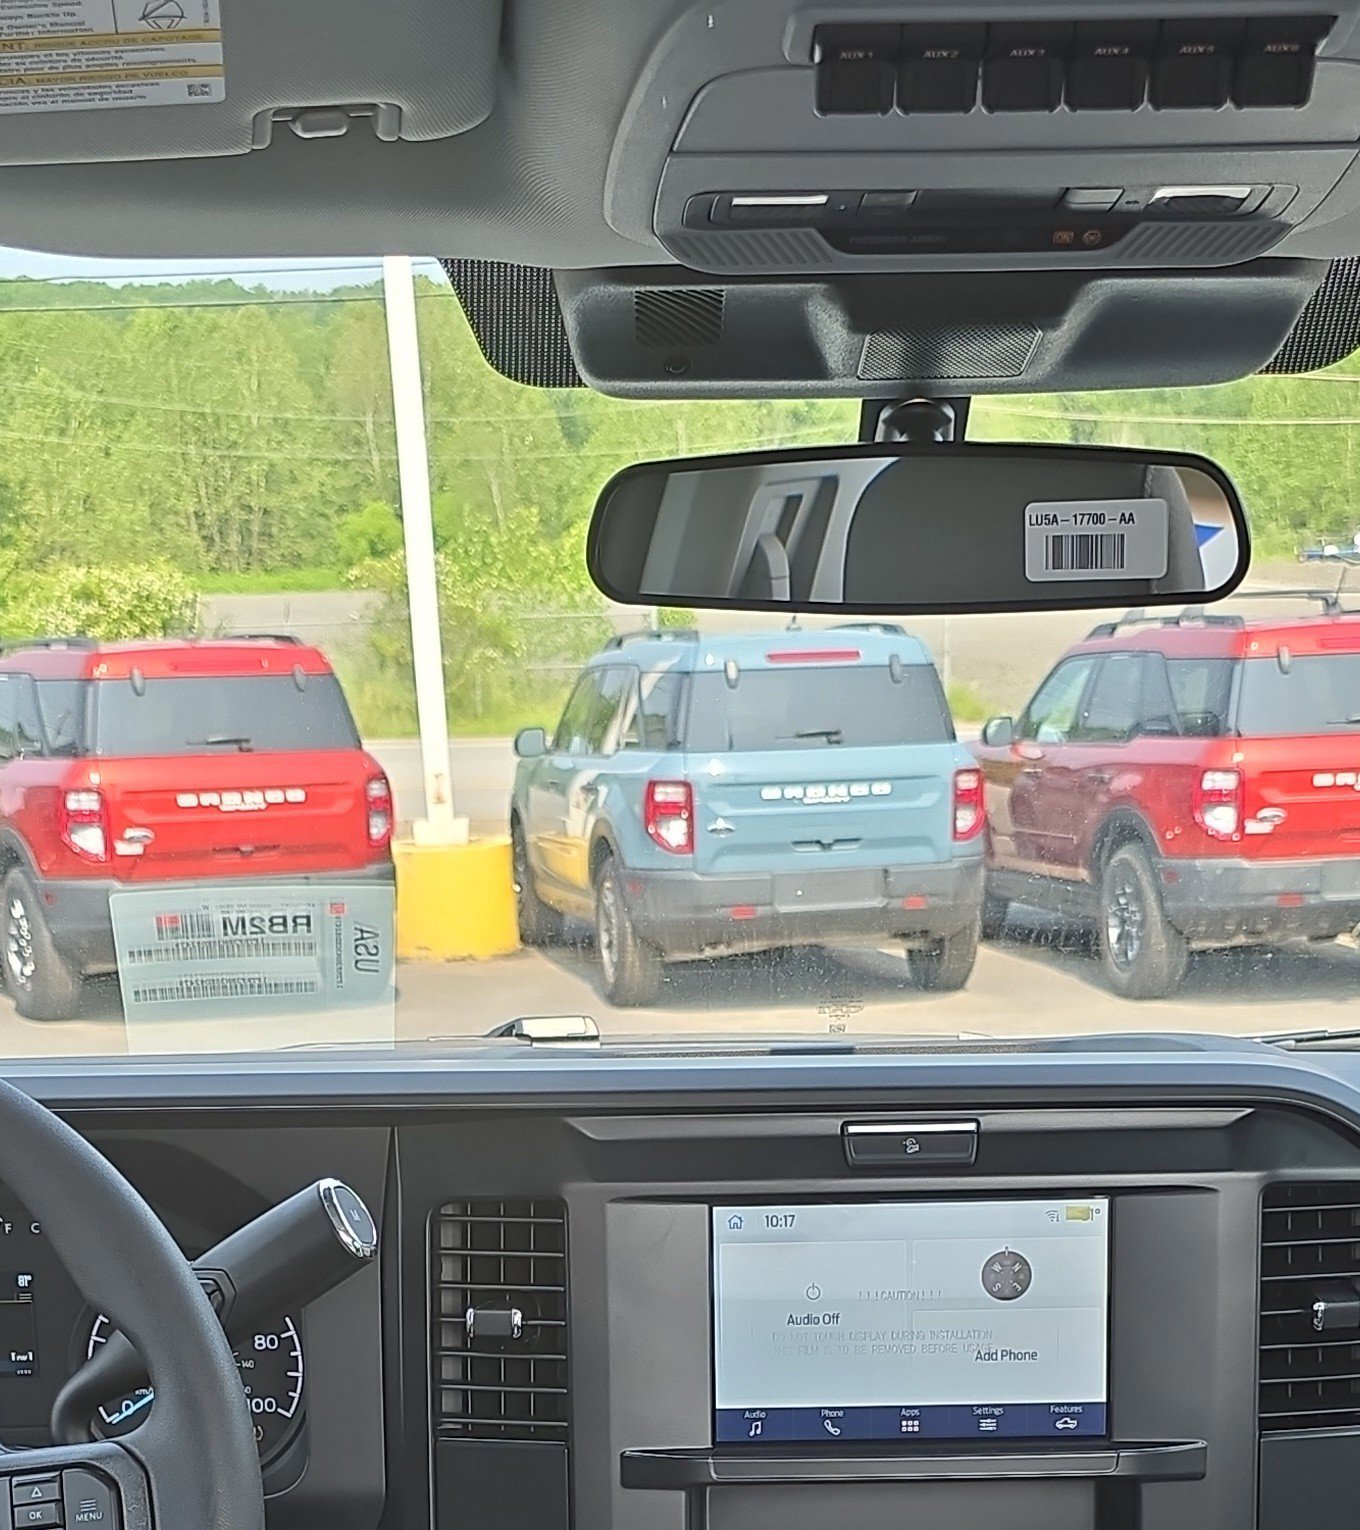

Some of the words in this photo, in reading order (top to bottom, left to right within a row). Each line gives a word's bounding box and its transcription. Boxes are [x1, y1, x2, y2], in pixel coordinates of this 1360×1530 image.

[764, 1215, 796, 1229] 10:17
[3, 1223, 13, 1235] F
[991, 1261, 1003, 1273] W
[1012, 1262, 1023, 1273] N
[992, 1282, 1002, 1292] S
[1012, 1282, 1022, 1292] E
[787, 1314, 820, 1326] Audio
[822, 1312, 841, 1326] Off
[930, 1329, 993, 1340] INSTALLATION
[253, 1334, 278, 1350] 80
[872, 1344, 916, 1354] REMOVED
[975, 1349, 998, 1362] Add
[1000, 1349, 1038, 1361] Phone
[744, 1409, 767, 1419] Audio
[821, 1408, 844, 1418] Phone
[900, 1408, 920, 1419] Apps
[972, 1406, 1004, 1417] Settings
[1050, 1404, 1083, 1415] Features
[28, 1510, 43, 1521] OK
[75, 1510, 104, 1522] MENU
